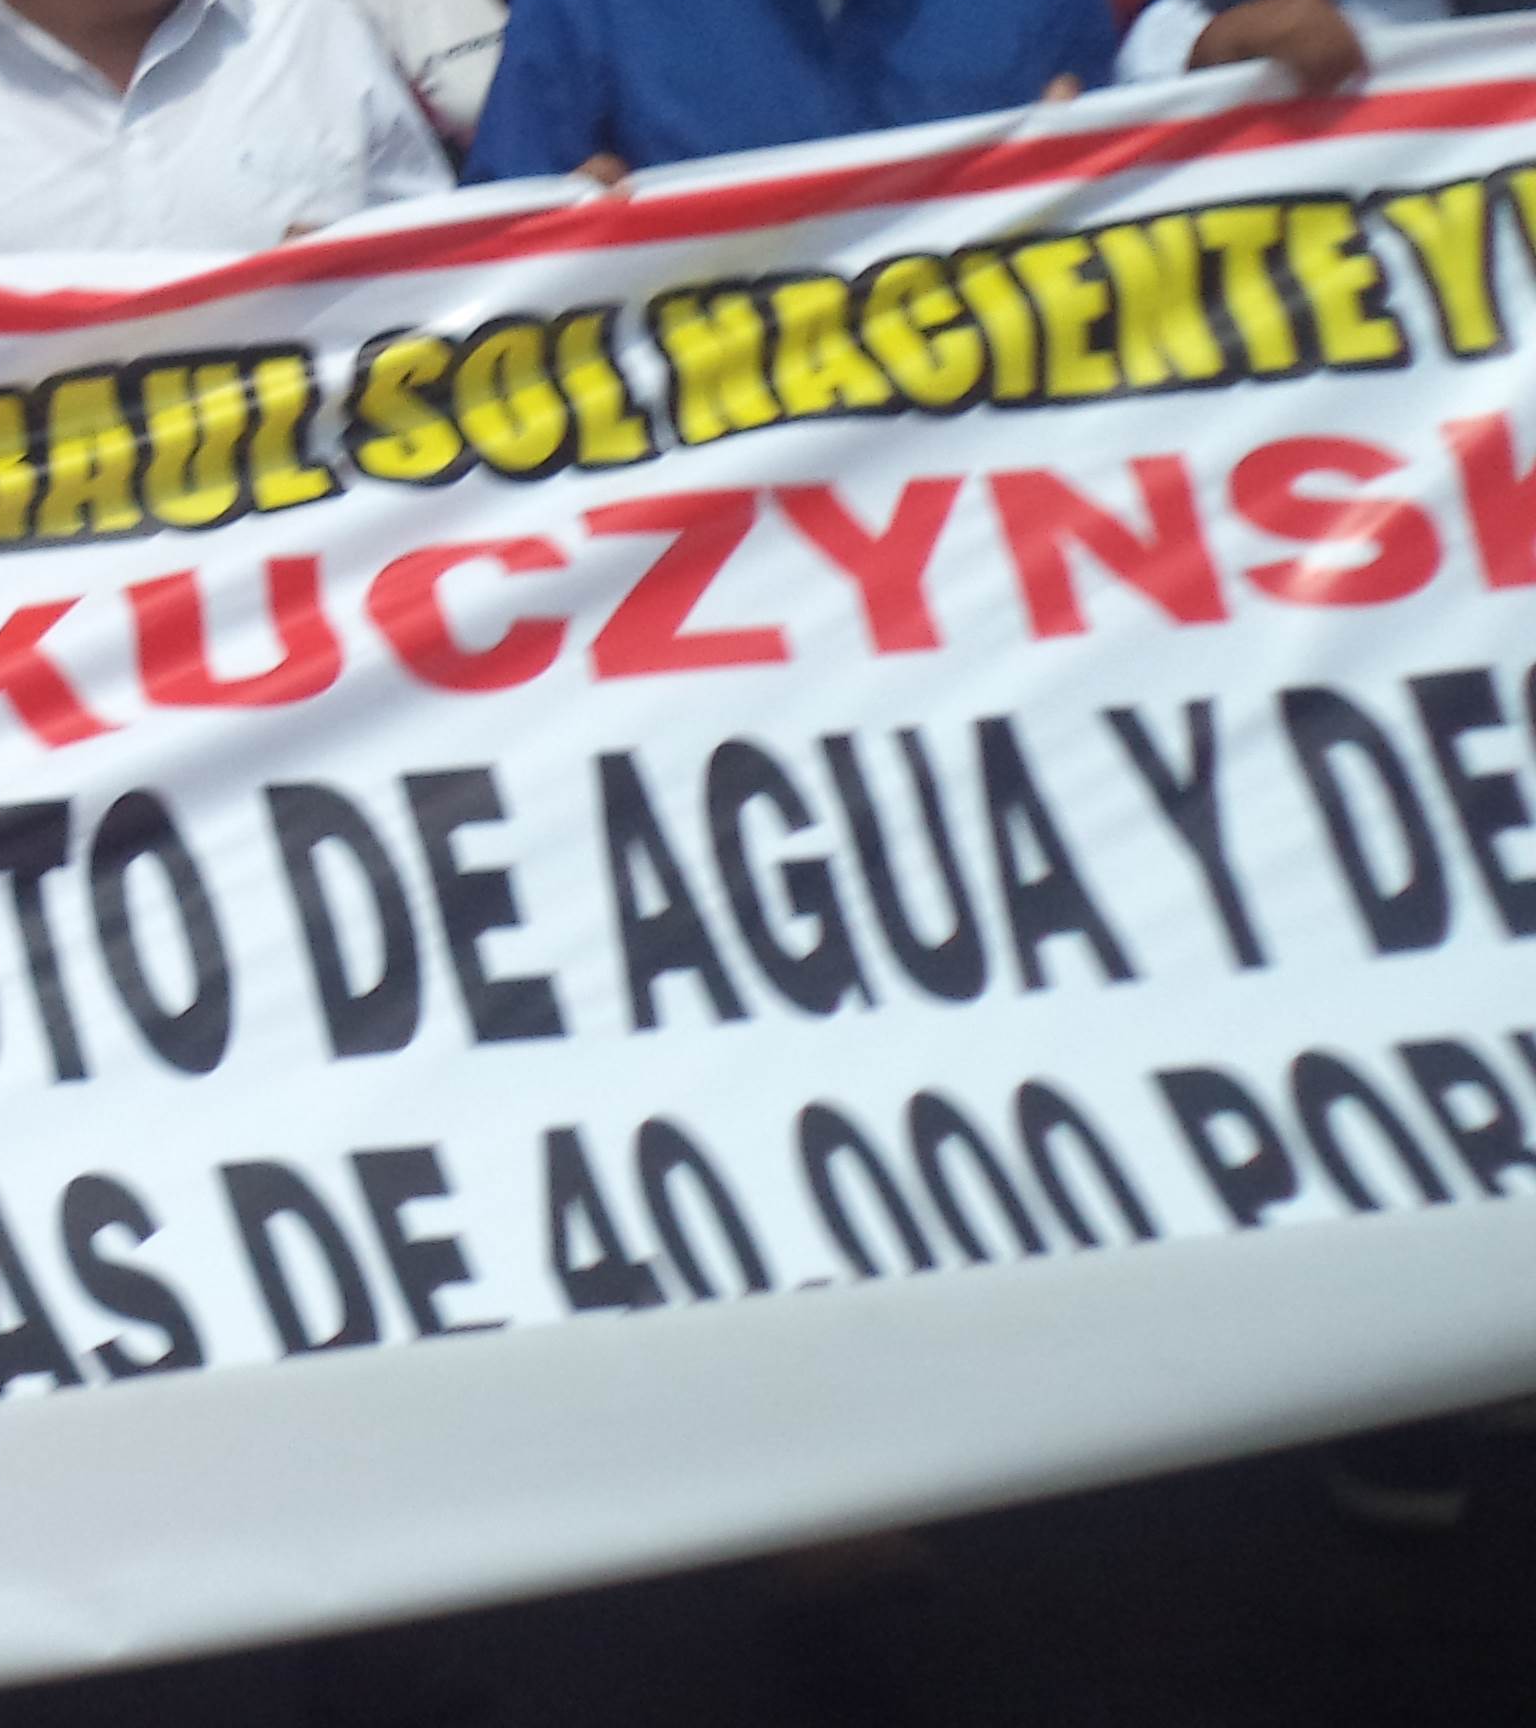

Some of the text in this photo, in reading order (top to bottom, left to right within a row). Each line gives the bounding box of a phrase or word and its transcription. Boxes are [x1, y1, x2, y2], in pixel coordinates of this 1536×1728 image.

[344, 301, 658, 489] SOL
[647, 192, 1414, 454] NACIENTE
[1360, 176, 1518, 365] Y
[263, 766, 569, 1061] DE
[594, 717, 1140, 1033] AGUA
[1102, 698, 1273, 970] Y
[1278, 665, 1536, 959] DE
[220, 1145, 510, 1362] DE
